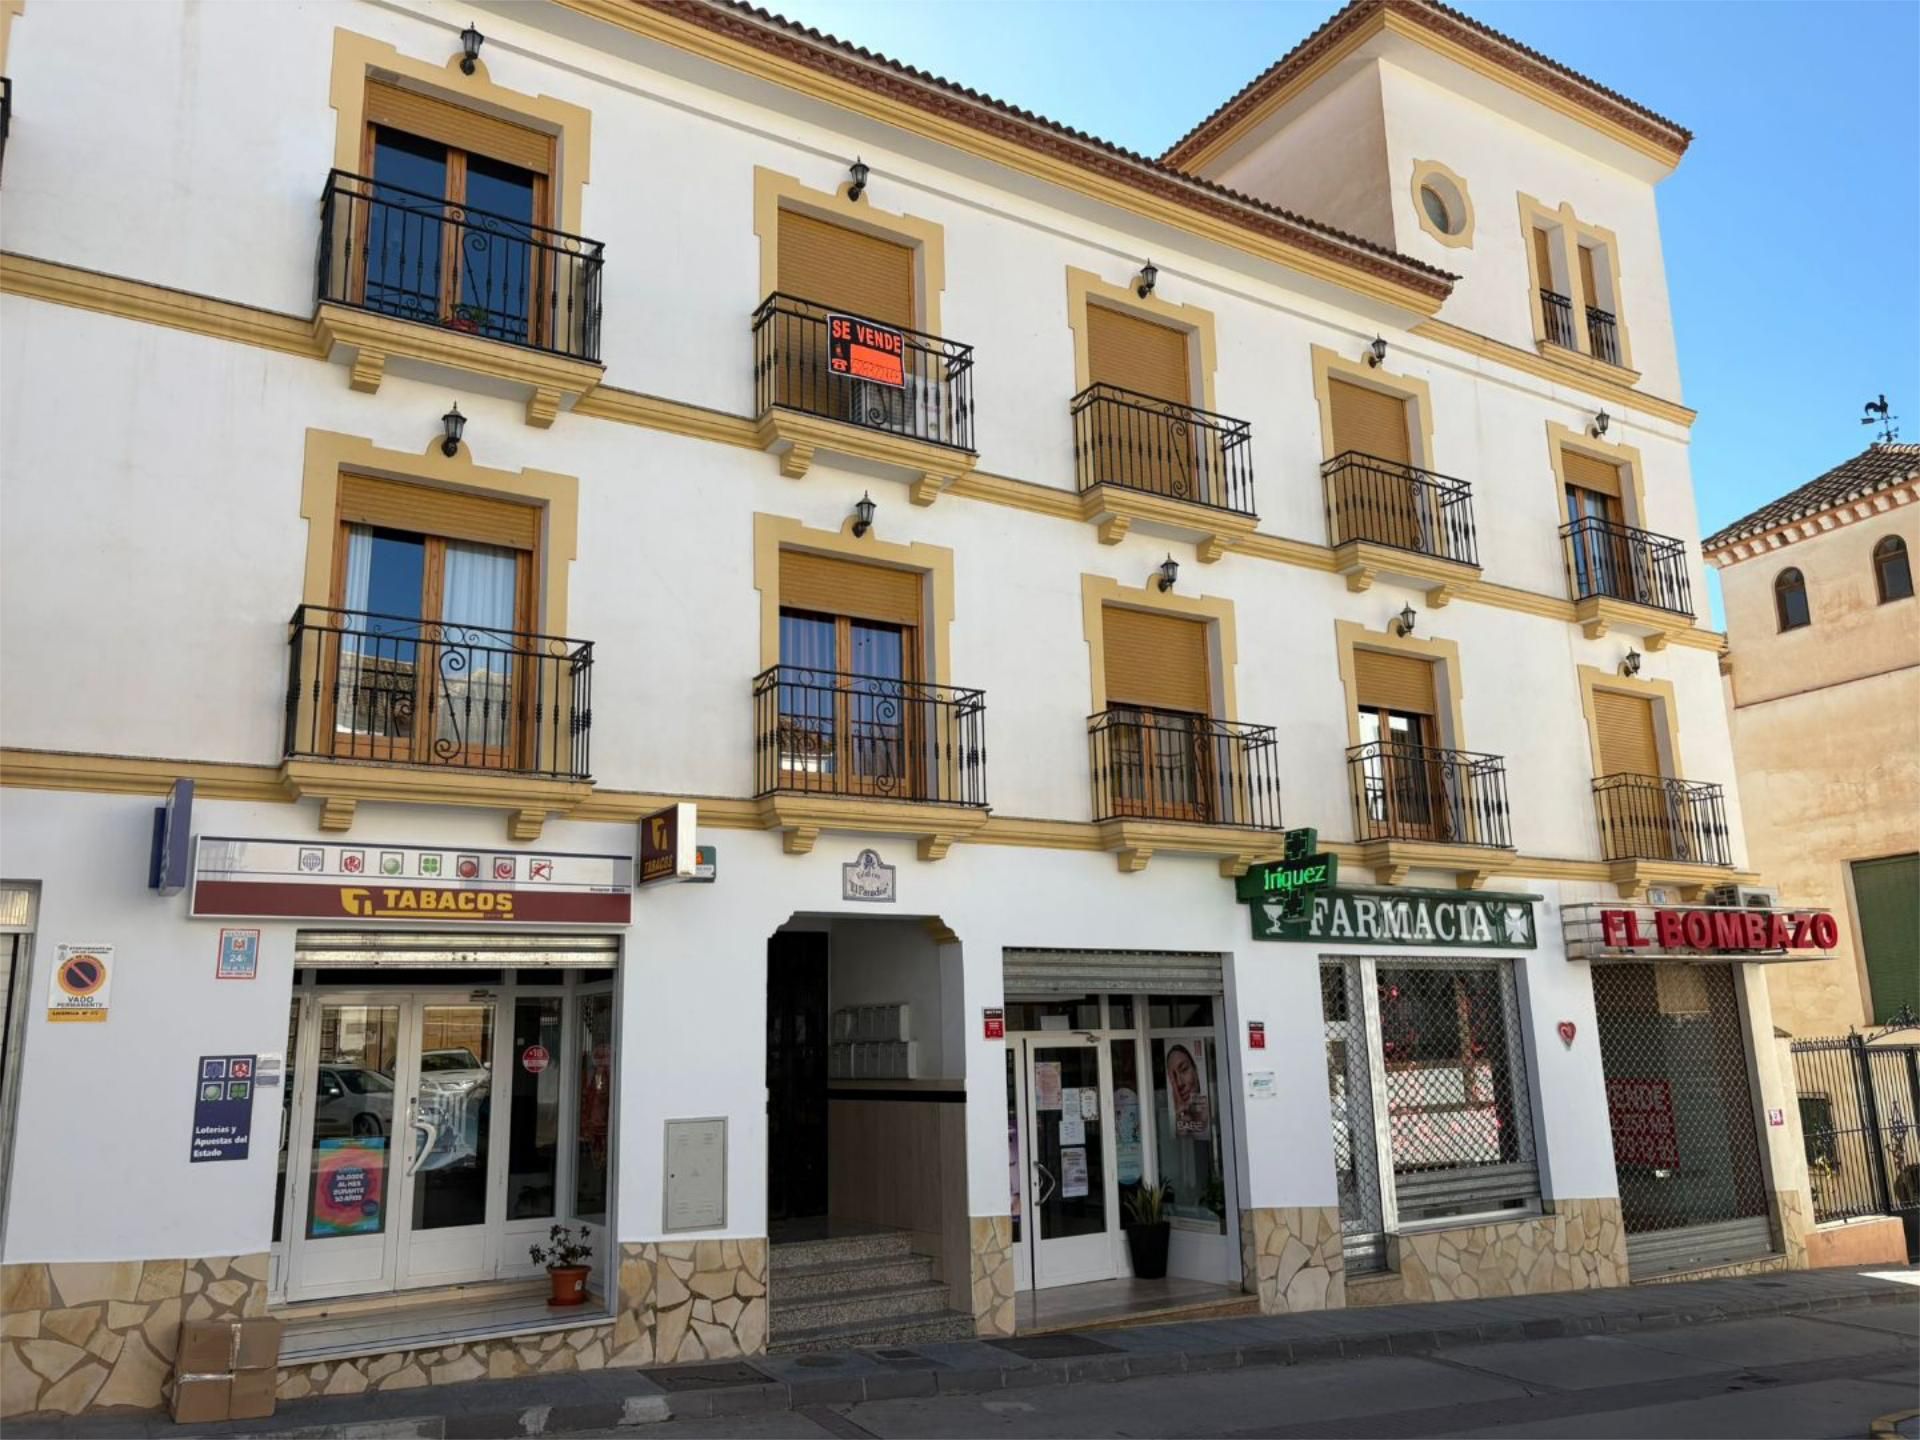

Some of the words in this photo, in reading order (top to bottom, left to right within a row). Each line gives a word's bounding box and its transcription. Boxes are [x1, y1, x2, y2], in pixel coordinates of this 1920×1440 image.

[832, 319, 851, 340] SE
[856, 324, 901, 355] VENDE
[643, 854, 673, 876] TABACOS
[383, 888, 513, 913] TABACOS
[1308, 896, 1493, 943] FARMACIA
[1600, 909, 1650, 948] EL
[1654, 910, 1839, 949] BOMBAZO
[194, 1137, 233, 1147] Apuestas
[234, 1135, 248, 1144] del
[231, 1126, 237, 1135] y
[193, 1148, 223, 1158] Estado
[333, 1187, 365, 1196] DURANTE
